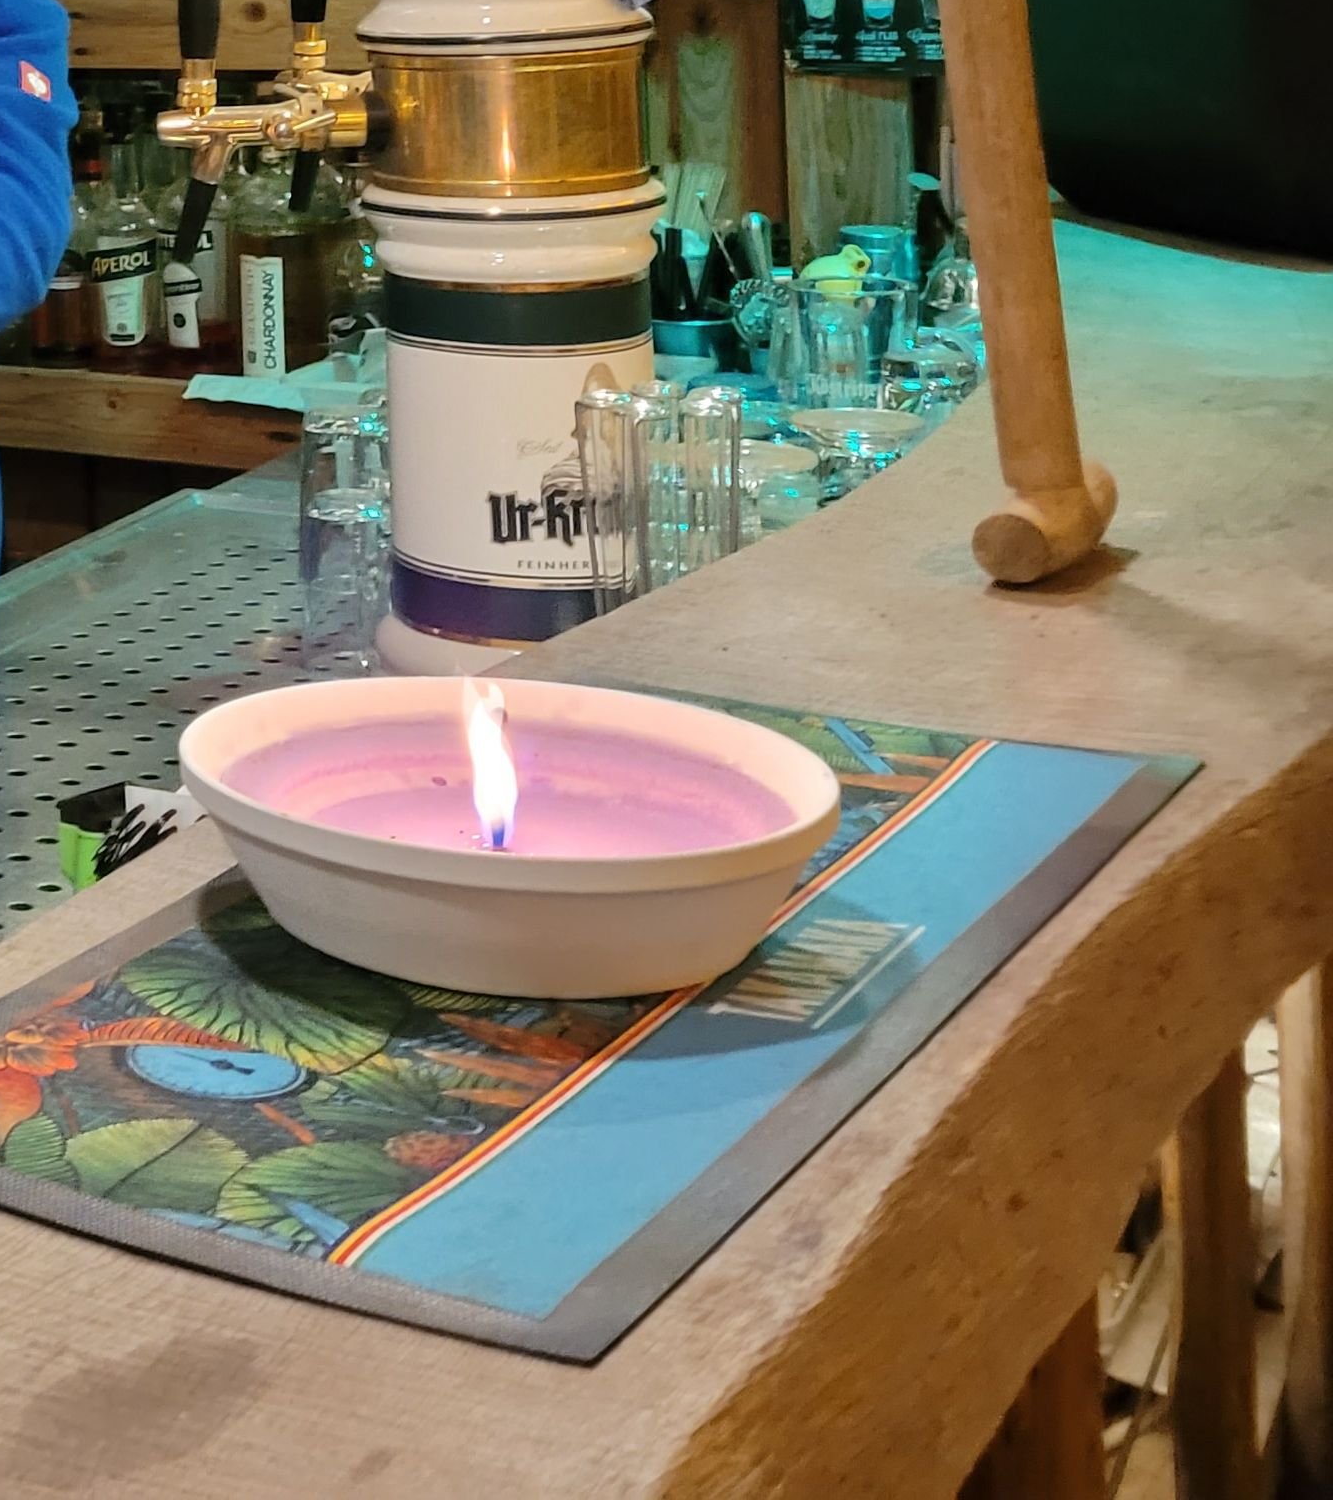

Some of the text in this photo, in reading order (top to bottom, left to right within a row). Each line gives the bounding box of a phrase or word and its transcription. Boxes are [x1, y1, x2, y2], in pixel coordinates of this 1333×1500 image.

[91, 250, 152, 276] APEROL
[262, 268, 278, 370] CHARDONNAY
[517, 559, 592, 571] FEINHER
